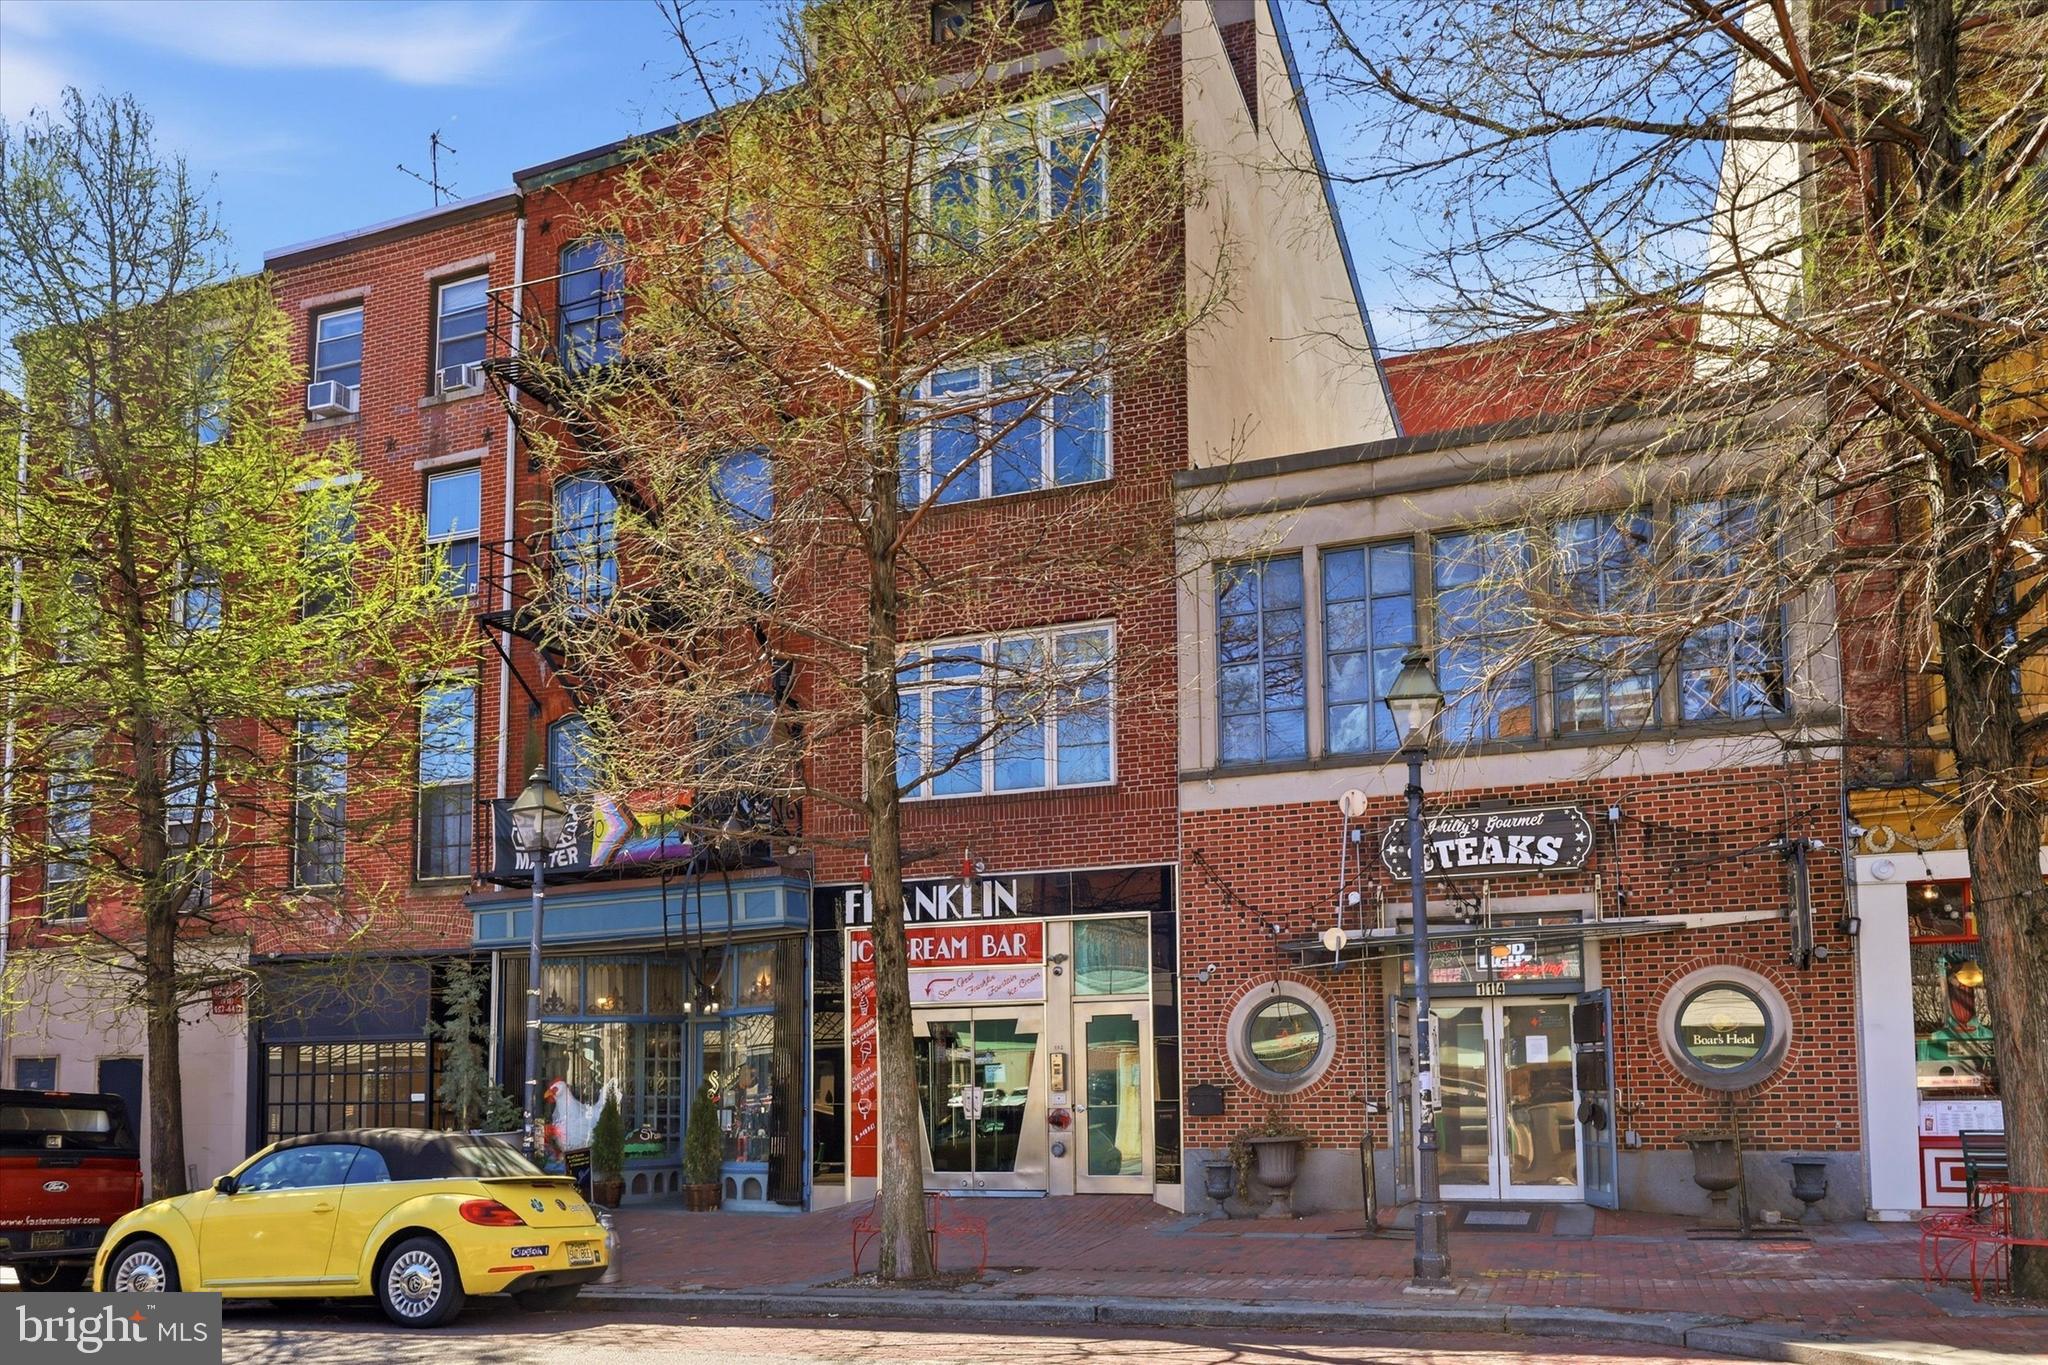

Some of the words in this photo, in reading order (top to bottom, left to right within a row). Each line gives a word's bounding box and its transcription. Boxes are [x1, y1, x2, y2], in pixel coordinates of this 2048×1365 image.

[1485, 812, 1545, 833] Gourmet
[515, 847, 579, 870] MTER
[851, 940, 874, 963] IC
[907, 935, 969, 961] REAM
[982, 933, 1027, 958] BAR
[1478, 983, 1505, 996] 114
[1693, 1033, 1724, 1045] Boar's
[1726, 1033, 1755, 1045] Head
